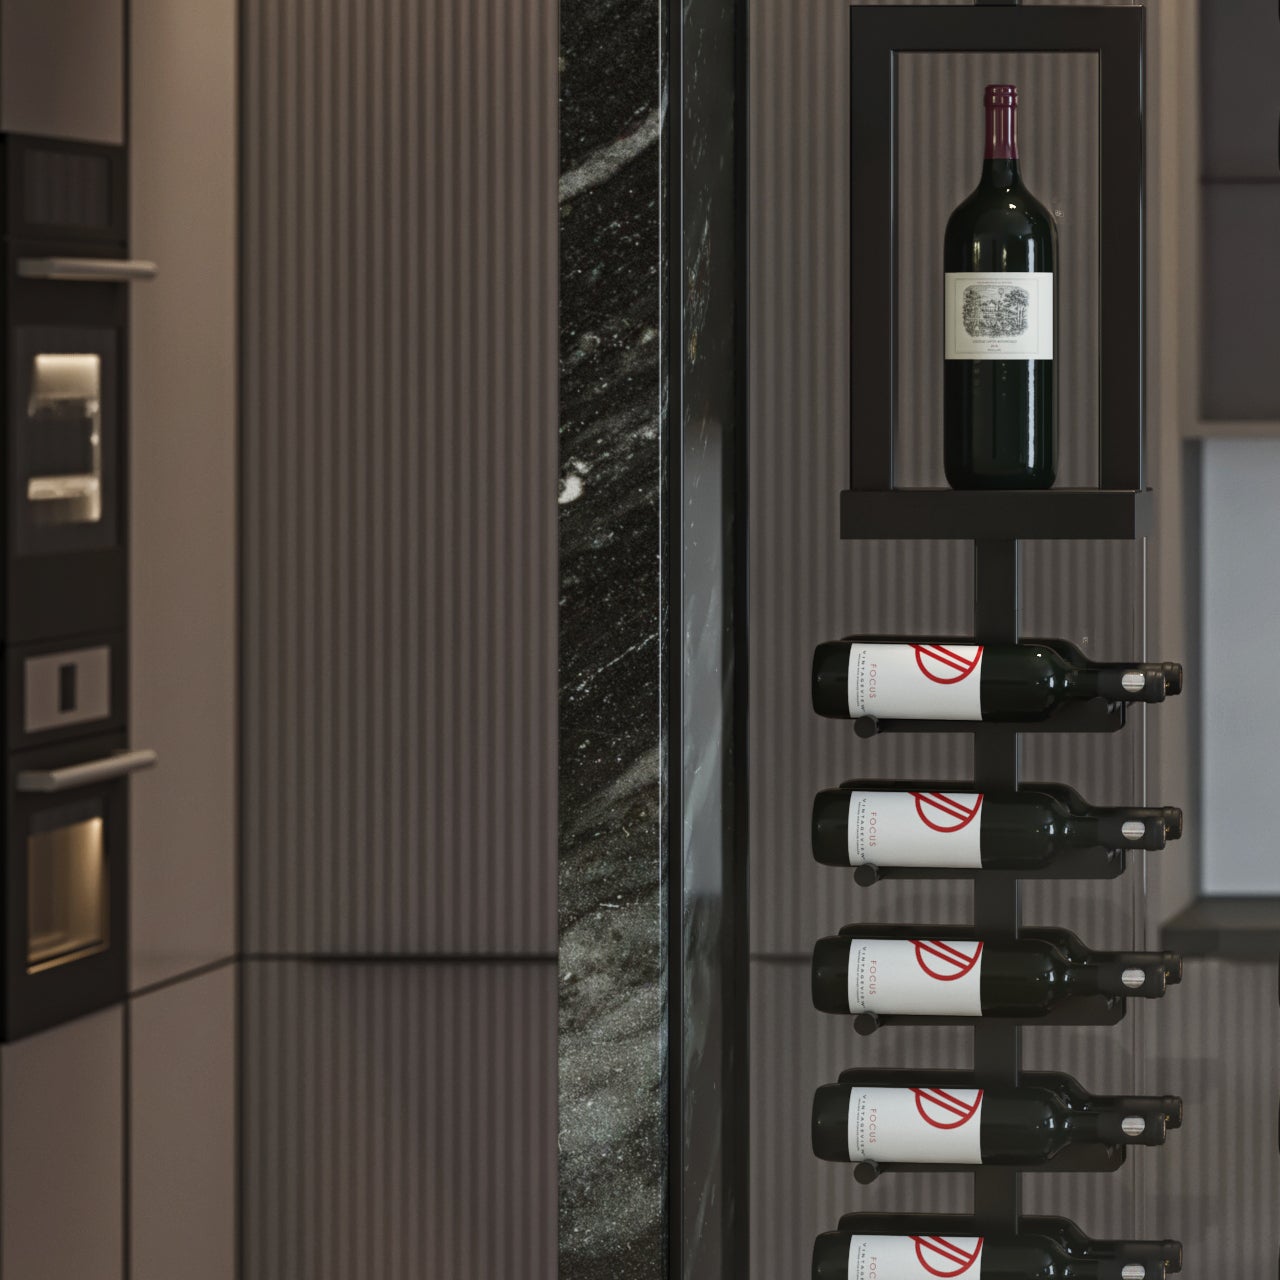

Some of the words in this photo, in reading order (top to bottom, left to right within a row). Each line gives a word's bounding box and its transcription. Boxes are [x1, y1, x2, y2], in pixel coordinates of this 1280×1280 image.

[869, 663, 877, 699] FOCUS
[869, 812, 877, 847] FOCUS
[869, 960, 877, 995] FOCUS
[869, 1108, 877, 1143] FOCUS
